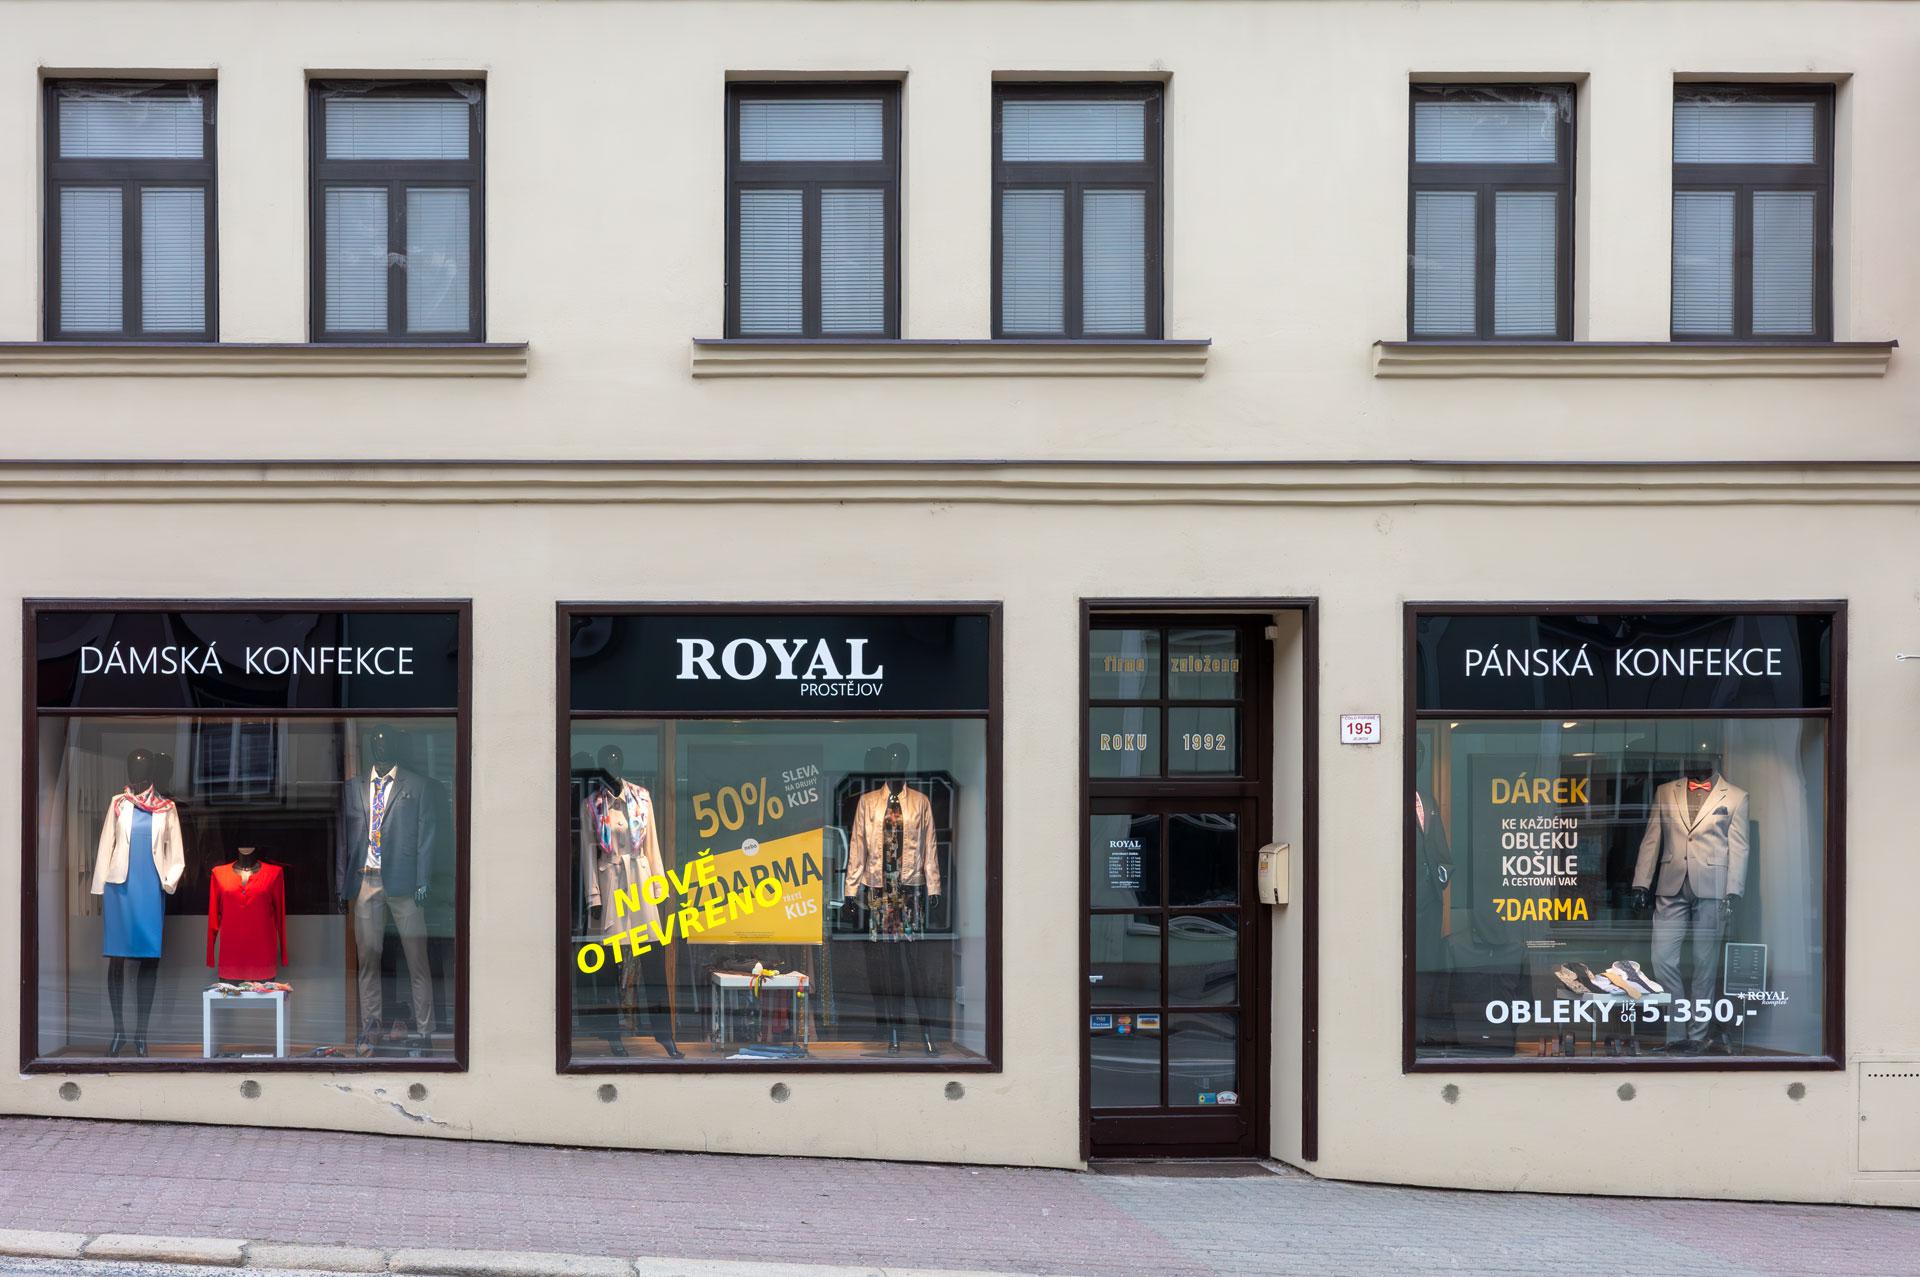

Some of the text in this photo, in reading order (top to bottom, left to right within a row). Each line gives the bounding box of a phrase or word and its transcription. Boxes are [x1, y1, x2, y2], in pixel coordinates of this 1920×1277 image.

[80, 641, 414, 675] DÁMSKÁ KONFEKCE
[676, 637, 884, 681] ROYAL
[1103, 655, 1239, 672] firma založena
[1465, 643, 1782, 677] PÁNSKÁ KONFEKCE
[800, 681, 883, 697] PROSTĚJOV
[1347, 722, 1373, 735] 195
[1100, 733, 1226, 751] ROKU 1992
[782, 764, 819, 783] SLEVA
[785, 783, 795, 791] NA
[786, 787, 818, 808] KUS
[1491, 771, 1590, 805] DÁREK
[692, 776, 785, 838] 50%
[1502, 815, 1578, 830] KE KAŽDÉMU
[1109, 840, 1142, 848] ROYAL
[1501, 831, 1578, 850] OBLEKU
[1502, 850, 1578, 876] KOŠILE
[613, 848, 719, 919] NOVĚ
[1502, 875, 1578, 887] A CESTOVNÍ VAK
[785, 898, 818, 920] KUS
[1492, 897, 1589, 921] ZDARMA
[577, 877, 784, 975] OTEVŘENO
[1747, 991, 1789, 1001] ROYAL
[1485, 999, 1757, 1027] OBLEKY již od 5.350,-
